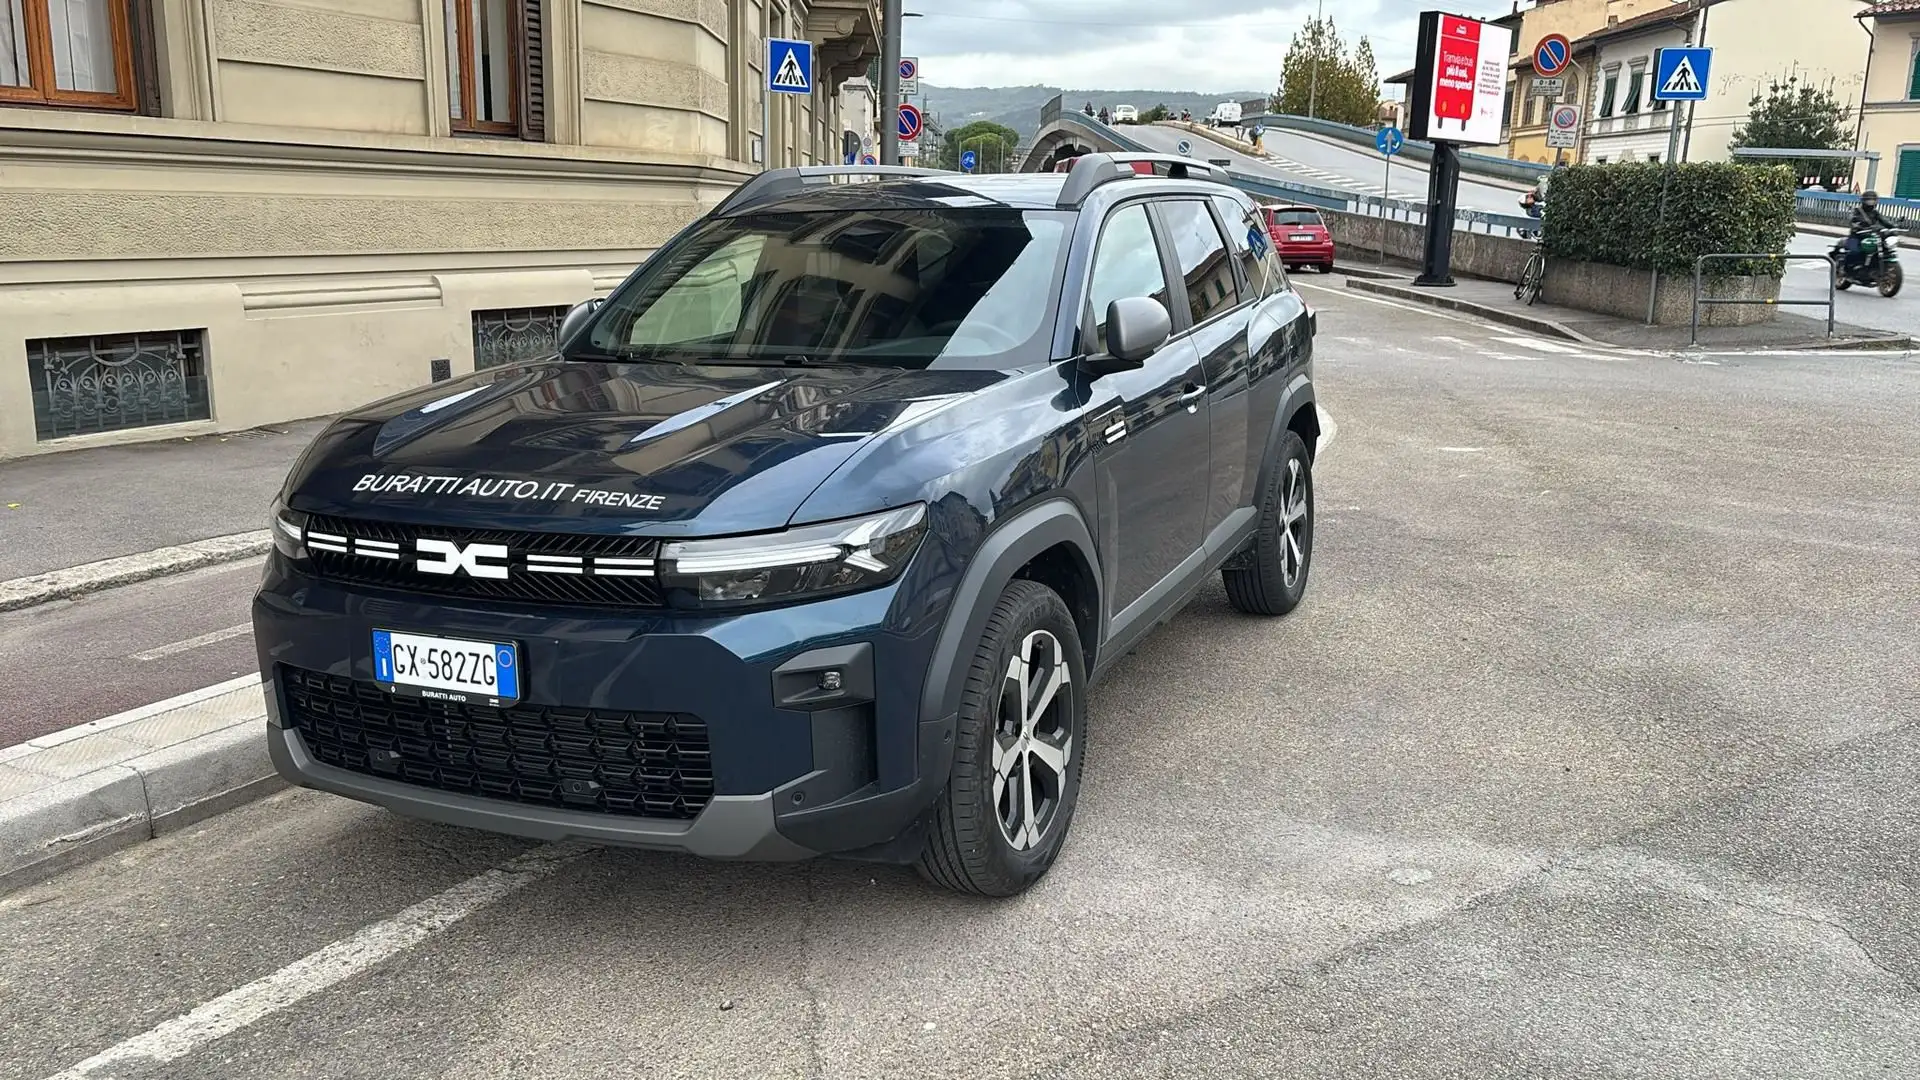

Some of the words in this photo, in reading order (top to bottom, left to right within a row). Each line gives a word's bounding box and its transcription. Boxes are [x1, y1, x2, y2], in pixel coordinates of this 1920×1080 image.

[352, 474, 459, 494] BURATTI
[457, 478, 576, 501] AUTO.IT
[571, 489, 666, 510] FIRENZE
[393, 644, 419, 677] GX
[427, 648, 495, 686] 582ZG
[422, 690, 448, 700] BURATTI
[448, 694, 466, 702] AUTO
